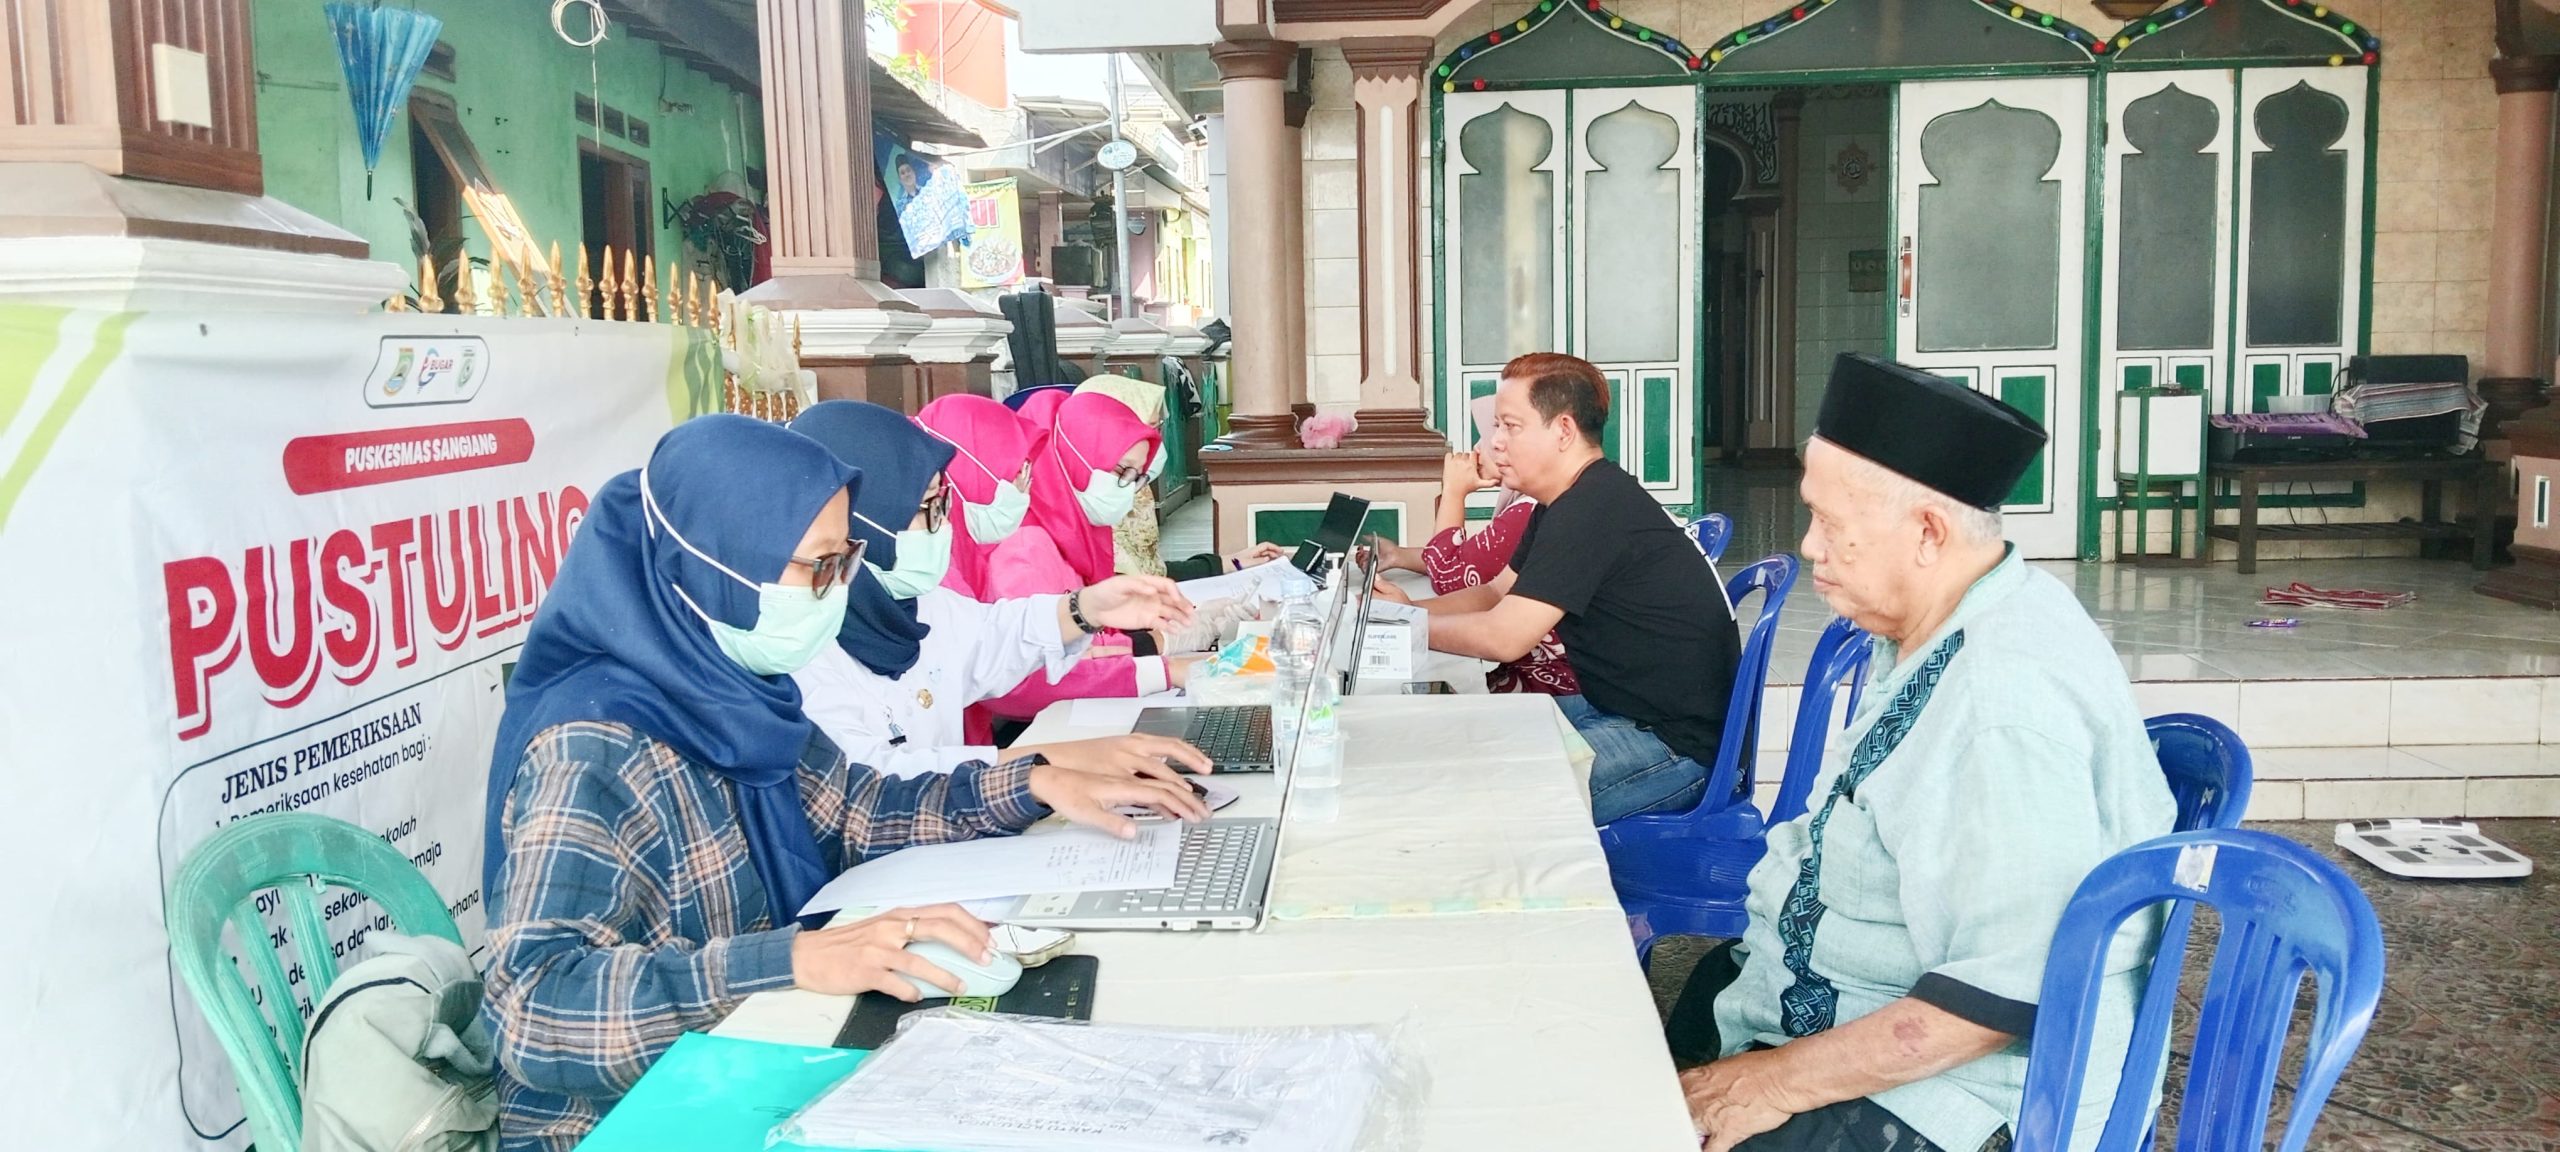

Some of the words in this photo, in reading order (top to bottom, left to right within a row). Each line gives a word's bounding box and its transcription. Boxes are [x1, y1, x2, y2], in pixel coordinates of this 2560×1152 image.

[345, 439, 432, 475] PUSKESMAS
[432, 433, 498, 462] SANGIANG
[221, 756, 288, 804] JENIS
[294, 702, 422, 776] PEMERIKSAAN
[230, 781, 330, 822] eriksaan
[333, 751, 400, 794] kesehatan
